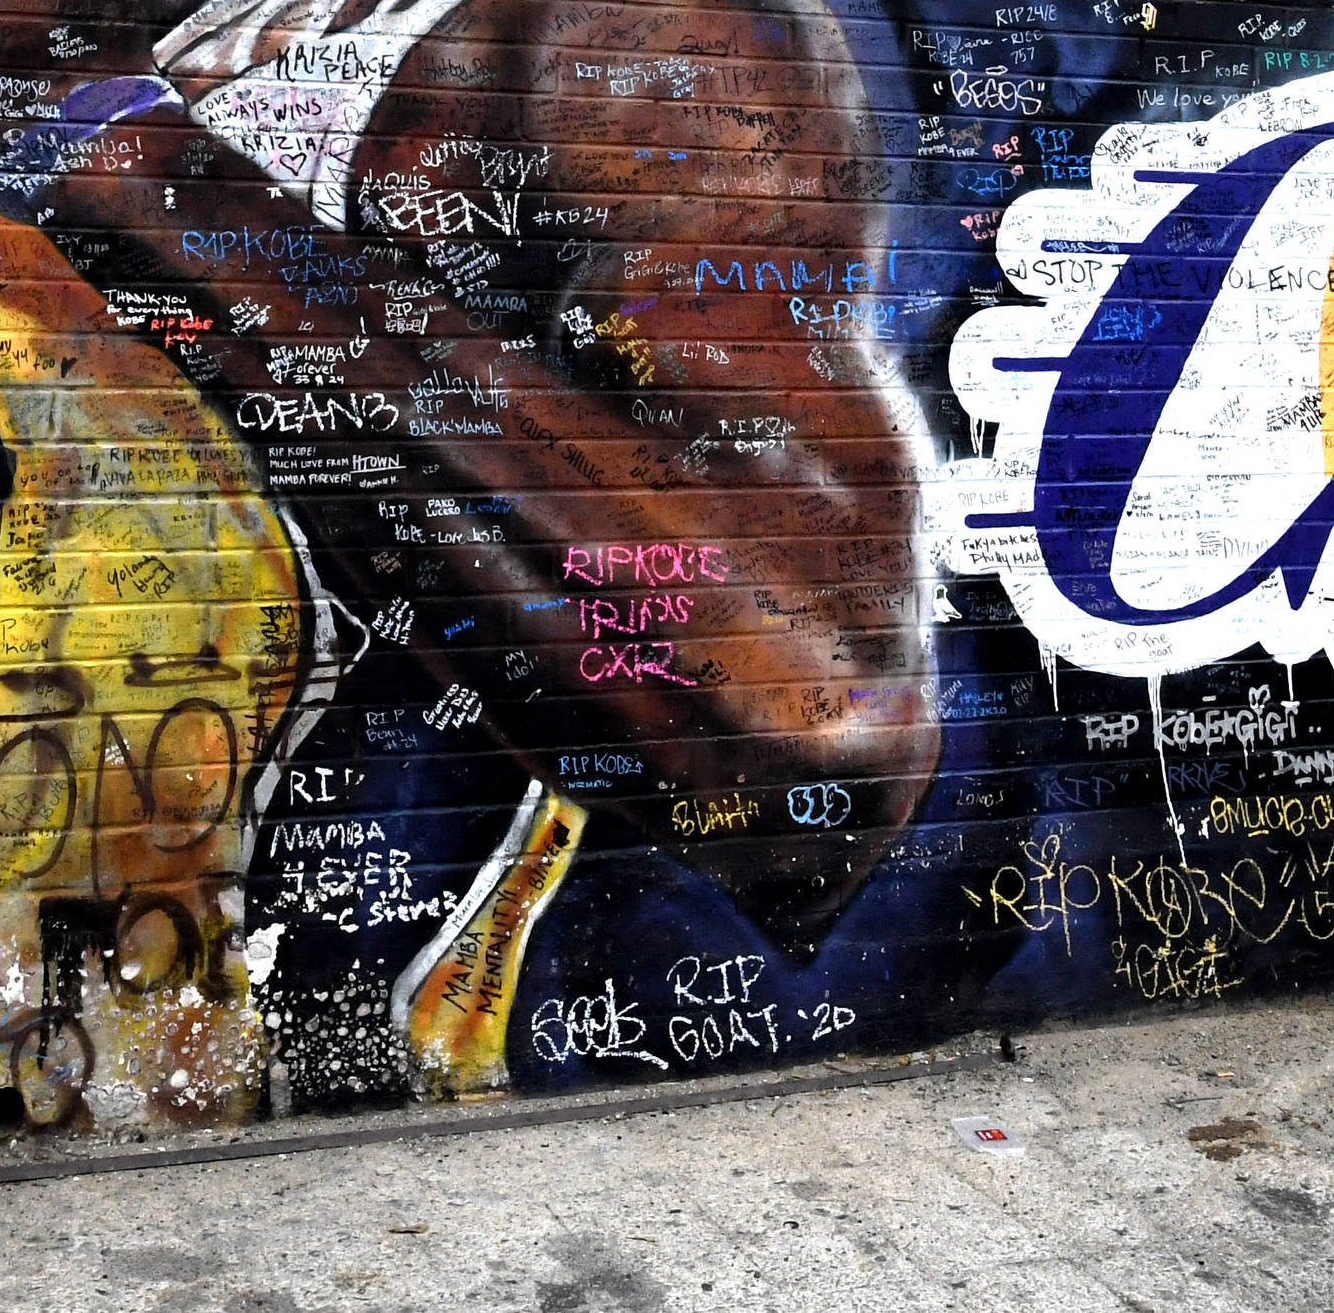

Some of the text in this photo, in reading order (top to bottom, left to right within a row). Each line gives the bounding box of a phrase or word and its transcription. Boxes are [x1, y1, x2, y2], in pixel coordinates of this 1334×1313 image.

[276, 40, 358, 81] KRIZIA
[1266, 51, 1289, 69] RIP
[1215, 63, 1249, 77] KOBE
[197, 93, 231, 115] LOVE
[1136, 89, 1211, 107] We love
[273, 98, 323, 119] WINS
[919, 117, 940, 130] RIP
[919, 128, 945, 141] KOBE
[623, 248, 652, 264] RIP
[1032, 259, 1104, 287] STOP
[1113, 262, 1171, 289] THE
[126, 306, 194, 322] everything
[385, 302, 413, 317] RIP
[151, 319, 176, 332] RIP
[295, 345, 347, 362] MAMBA
[416, 399, 443, 414] RIP
[268, 446, 316, 457] RIP KOBE!
[269, 458, 298, 469] MUCH
[301, 458, 323, 469] LOVE
[351, 454, 402, 471] HTOWN
[269, 474, 305, 485] MAMBA
[427, 498, 455, 508] PAKO
[1084, 714, 1139, 749] RIP
[441, 931, 483, 1013] MAMBA
